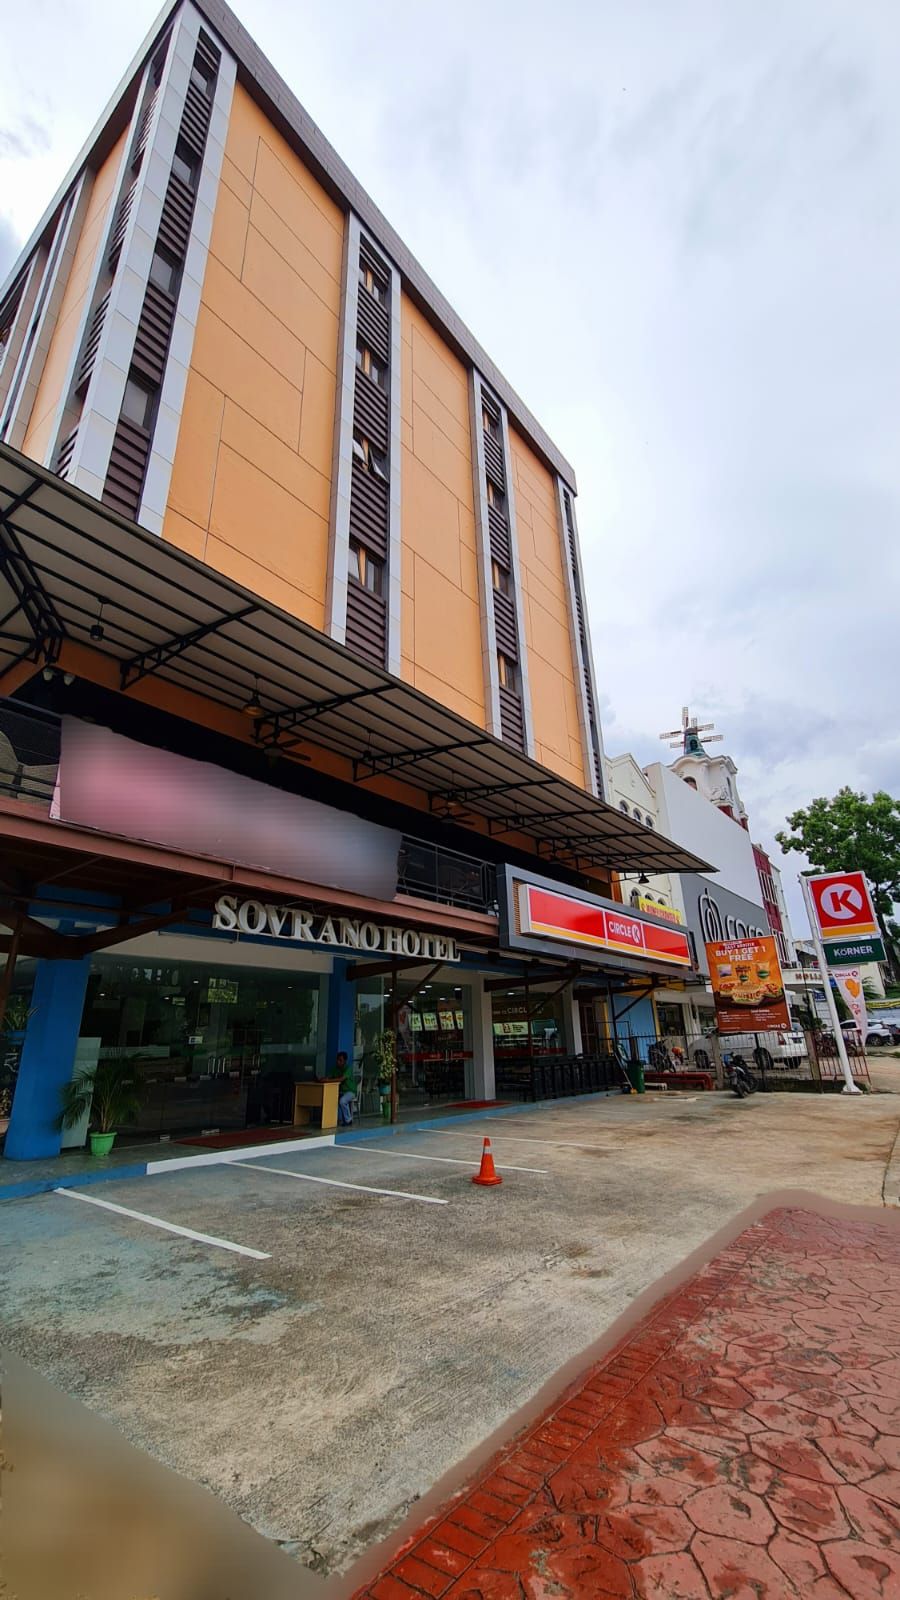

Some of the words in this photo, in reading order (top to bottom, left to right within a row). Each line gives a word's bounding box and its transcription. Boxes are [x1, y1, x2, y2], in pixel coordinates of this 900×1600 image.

[829, 888, 862, 916] K
[213, 895, 381, 950] SOVRANO
[382, 925, 461, 962] HOTEL
[608, 921, 632, 938] CIRCLE
[715, 949, 733, 957] BUY
[741, 946, 759, 954] GET
[729, 954, 754, 962] FREE
